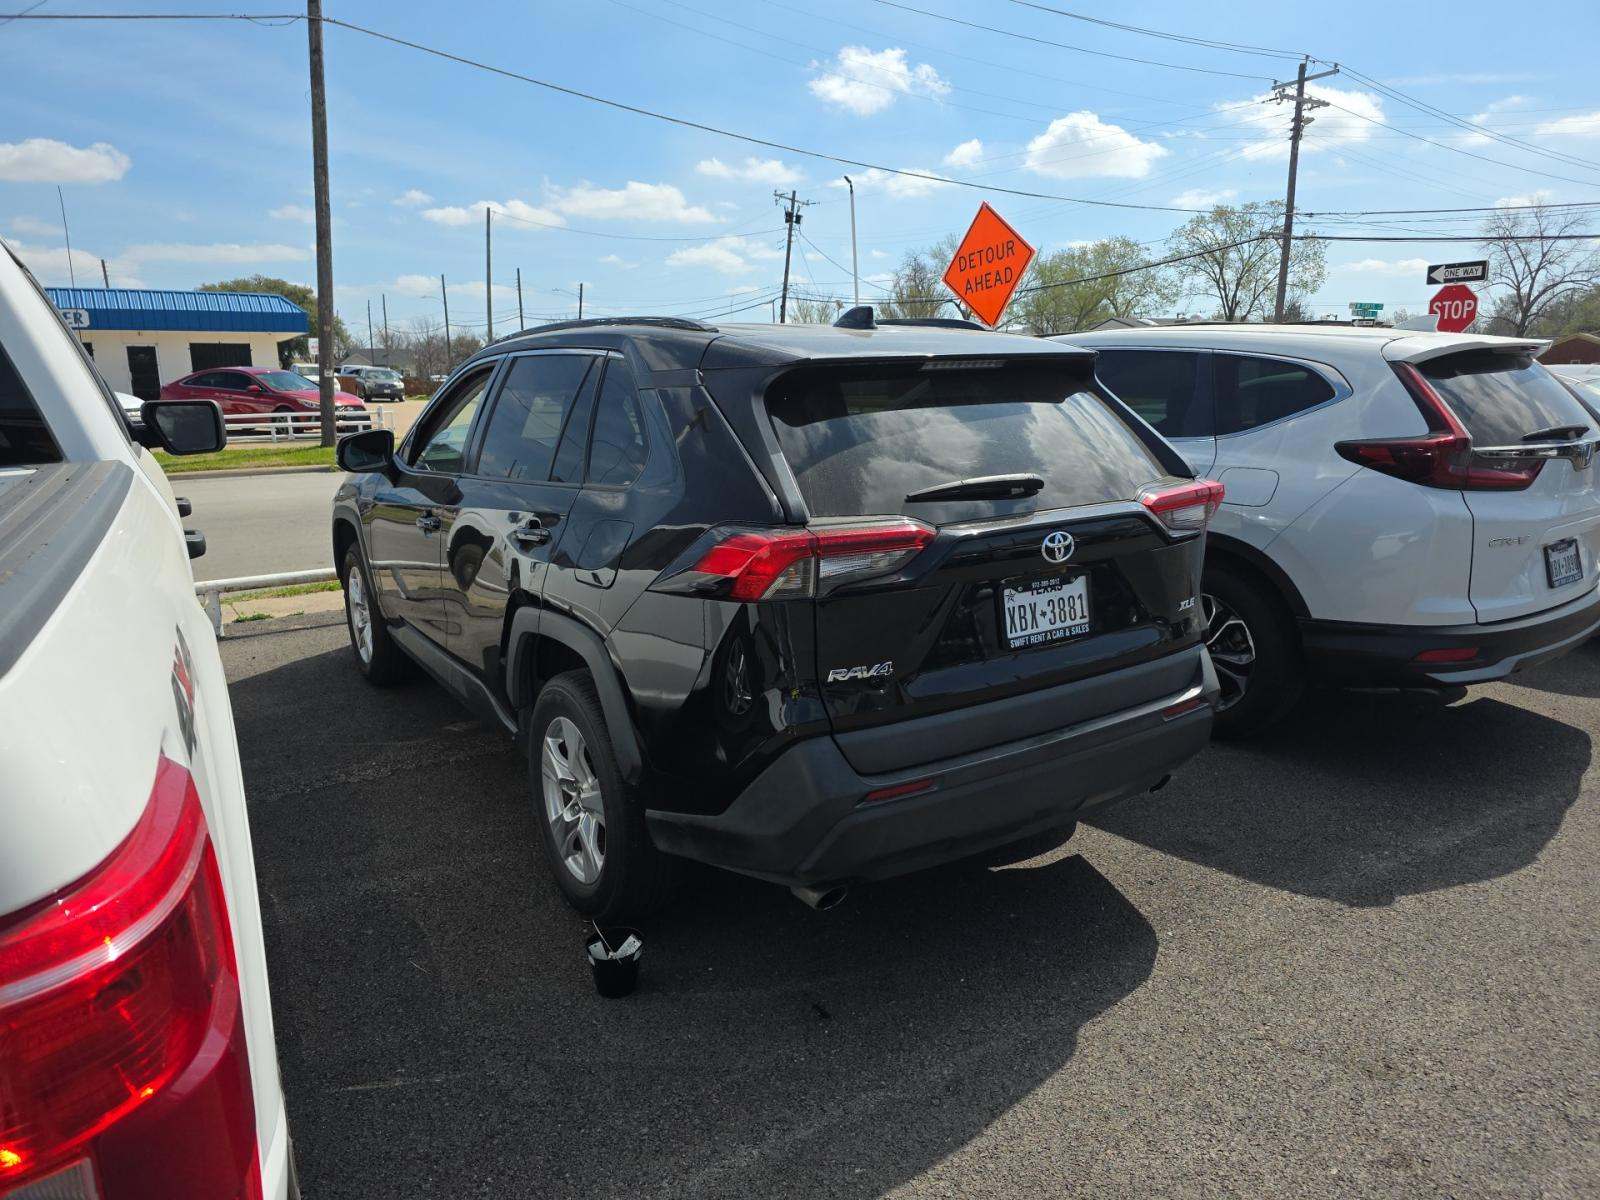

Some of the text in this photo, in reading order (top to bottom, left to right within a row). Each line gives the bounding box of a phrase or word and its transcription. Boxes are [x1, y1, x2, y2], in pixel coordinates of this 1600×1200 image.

[958, 240, 1015, 272] DETOUR
[965, 266, 1013, 295] AHEAD
[1443, 267, 1479, 278] ONE WAY
[1432, 300, 1475, 320] STOP
[1010, 637, 1029, 649] SWIFT
[1030, 633, 1046, 644] RENT
[1052, 629, 1065, 639] CAR
[1071, 624, 1090, 635] SALES
[827, 661, 893, 683] RAV4
